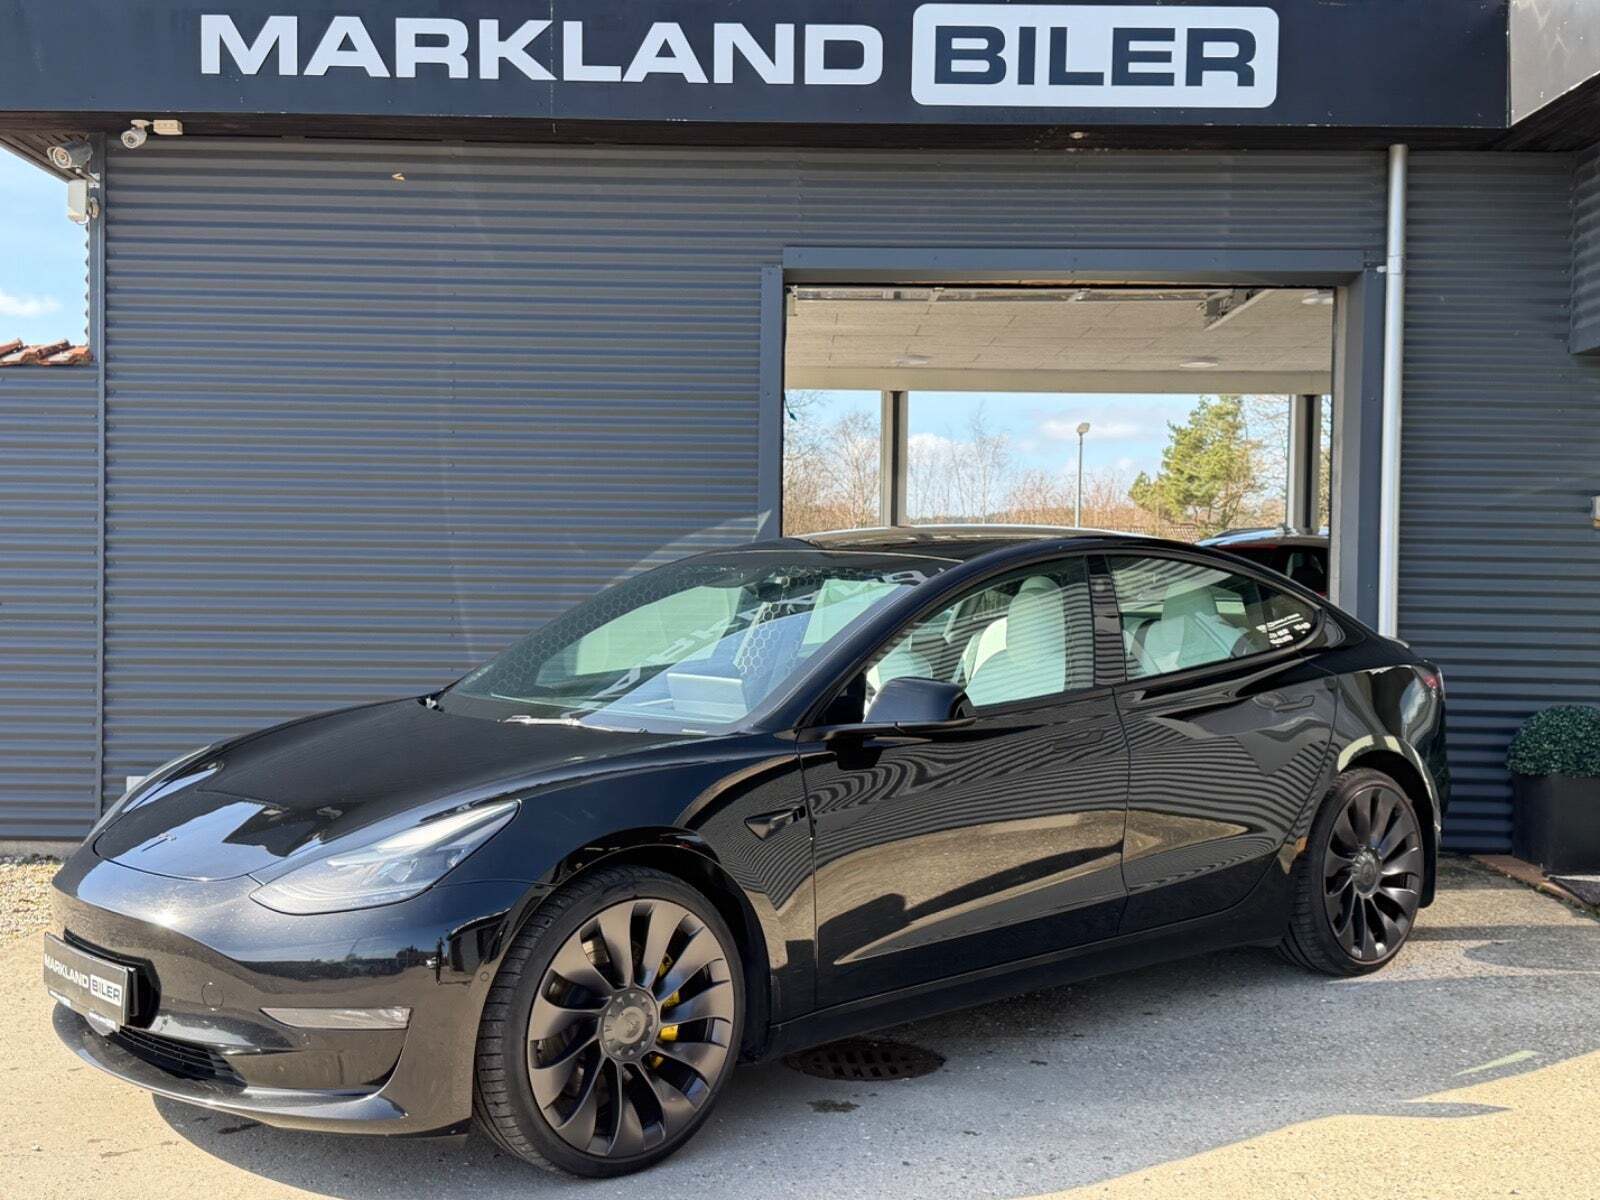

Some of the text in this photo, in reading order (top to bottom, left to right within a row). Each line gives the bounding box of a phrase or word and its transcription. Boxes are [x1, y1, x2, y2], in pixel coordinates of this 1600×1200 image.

[200, 14, 1257, 87] MARKLAND BILER
[44, 953, 89, 989] MARKLAND
[91, 979, 121, 1002] BILER
